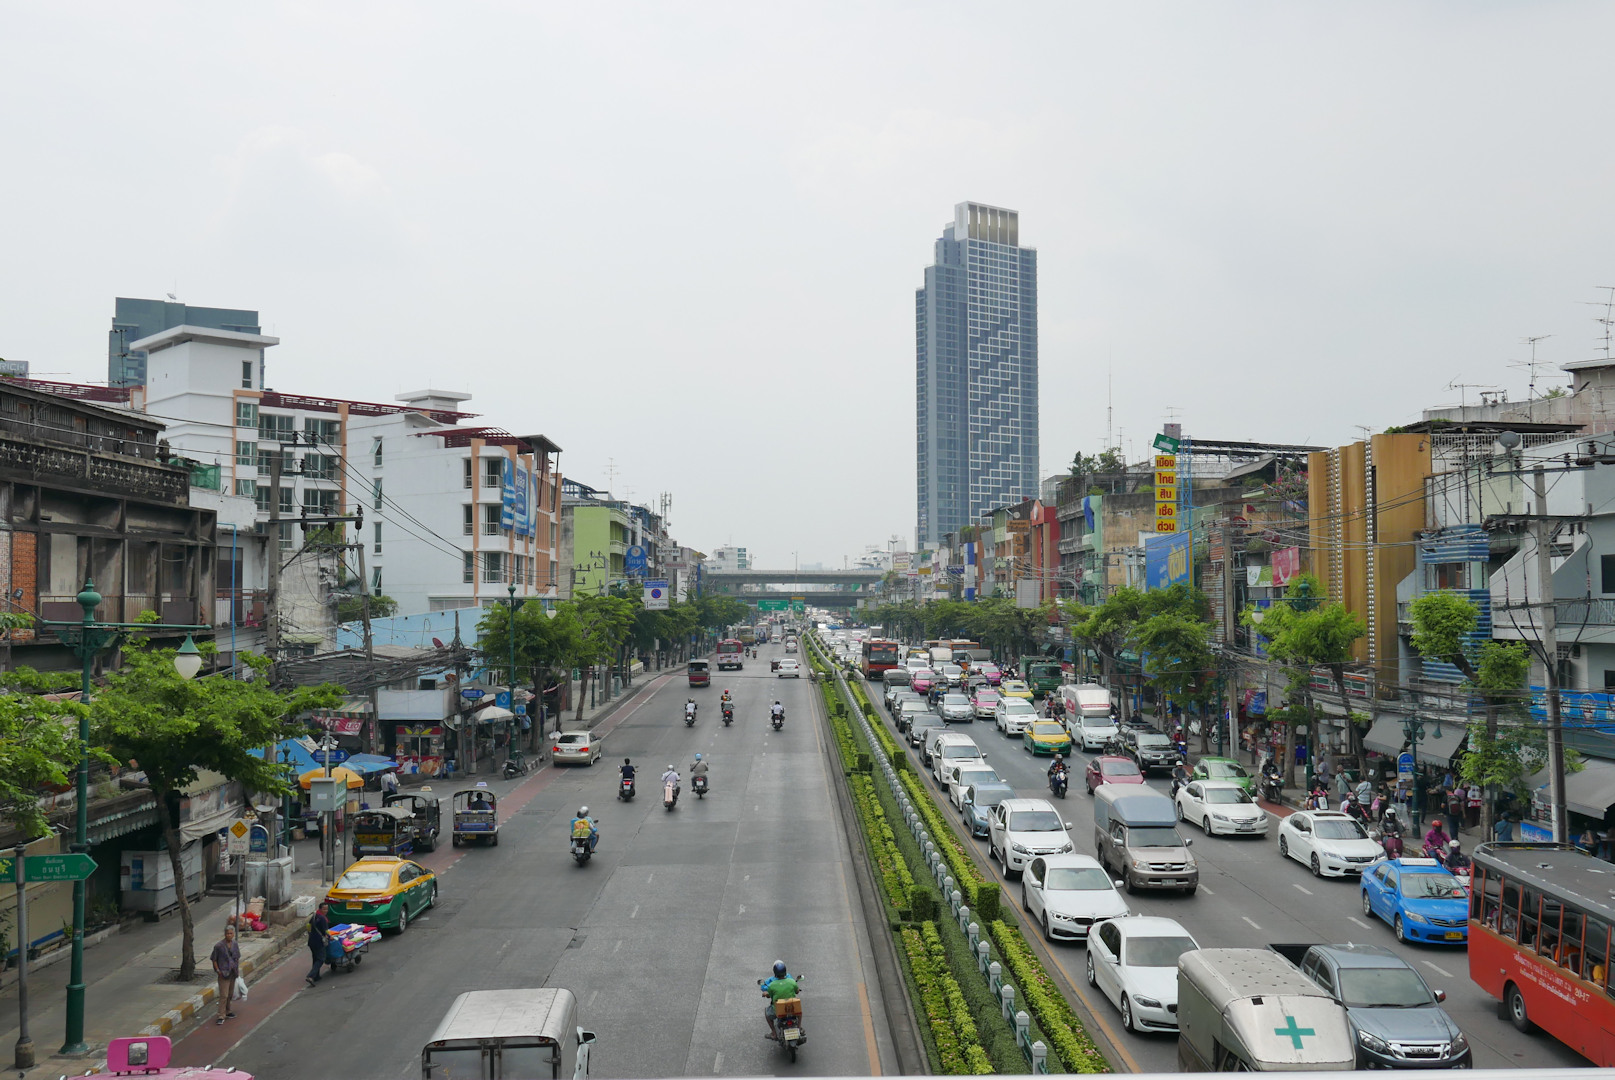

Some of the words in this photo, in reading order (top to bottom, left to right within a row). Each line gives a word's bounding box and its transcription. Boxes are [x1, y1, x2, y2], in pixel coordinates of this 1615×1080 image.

[1156, 457, 1175, 467] เมือง
[1157, 473, 1174, 484] ไทย
[1159, 489, 1172, 499] สิน
[1158, 504, 1173, 516] เชื่อ
[1157, 521, 1175, 531] ด่วน
